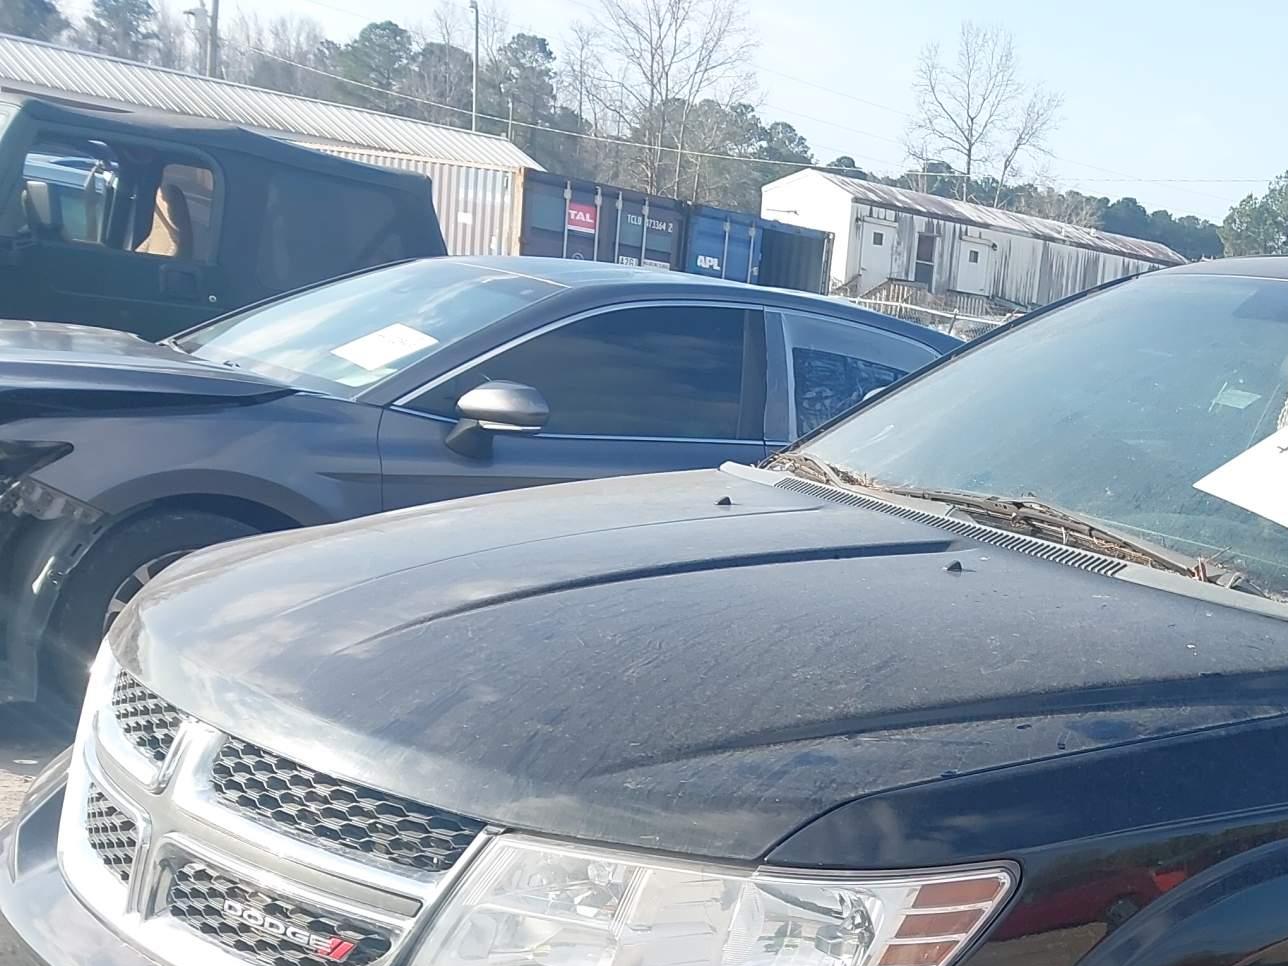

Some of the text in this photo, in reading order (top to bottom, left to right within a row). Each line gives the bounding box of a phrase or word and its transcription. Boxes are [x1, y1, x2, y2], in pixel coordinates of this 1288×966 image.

[568, 209, 594, 223] TAL
[696, 255, 721, 271] APL
[223, 899, 332, 953] DODGE
